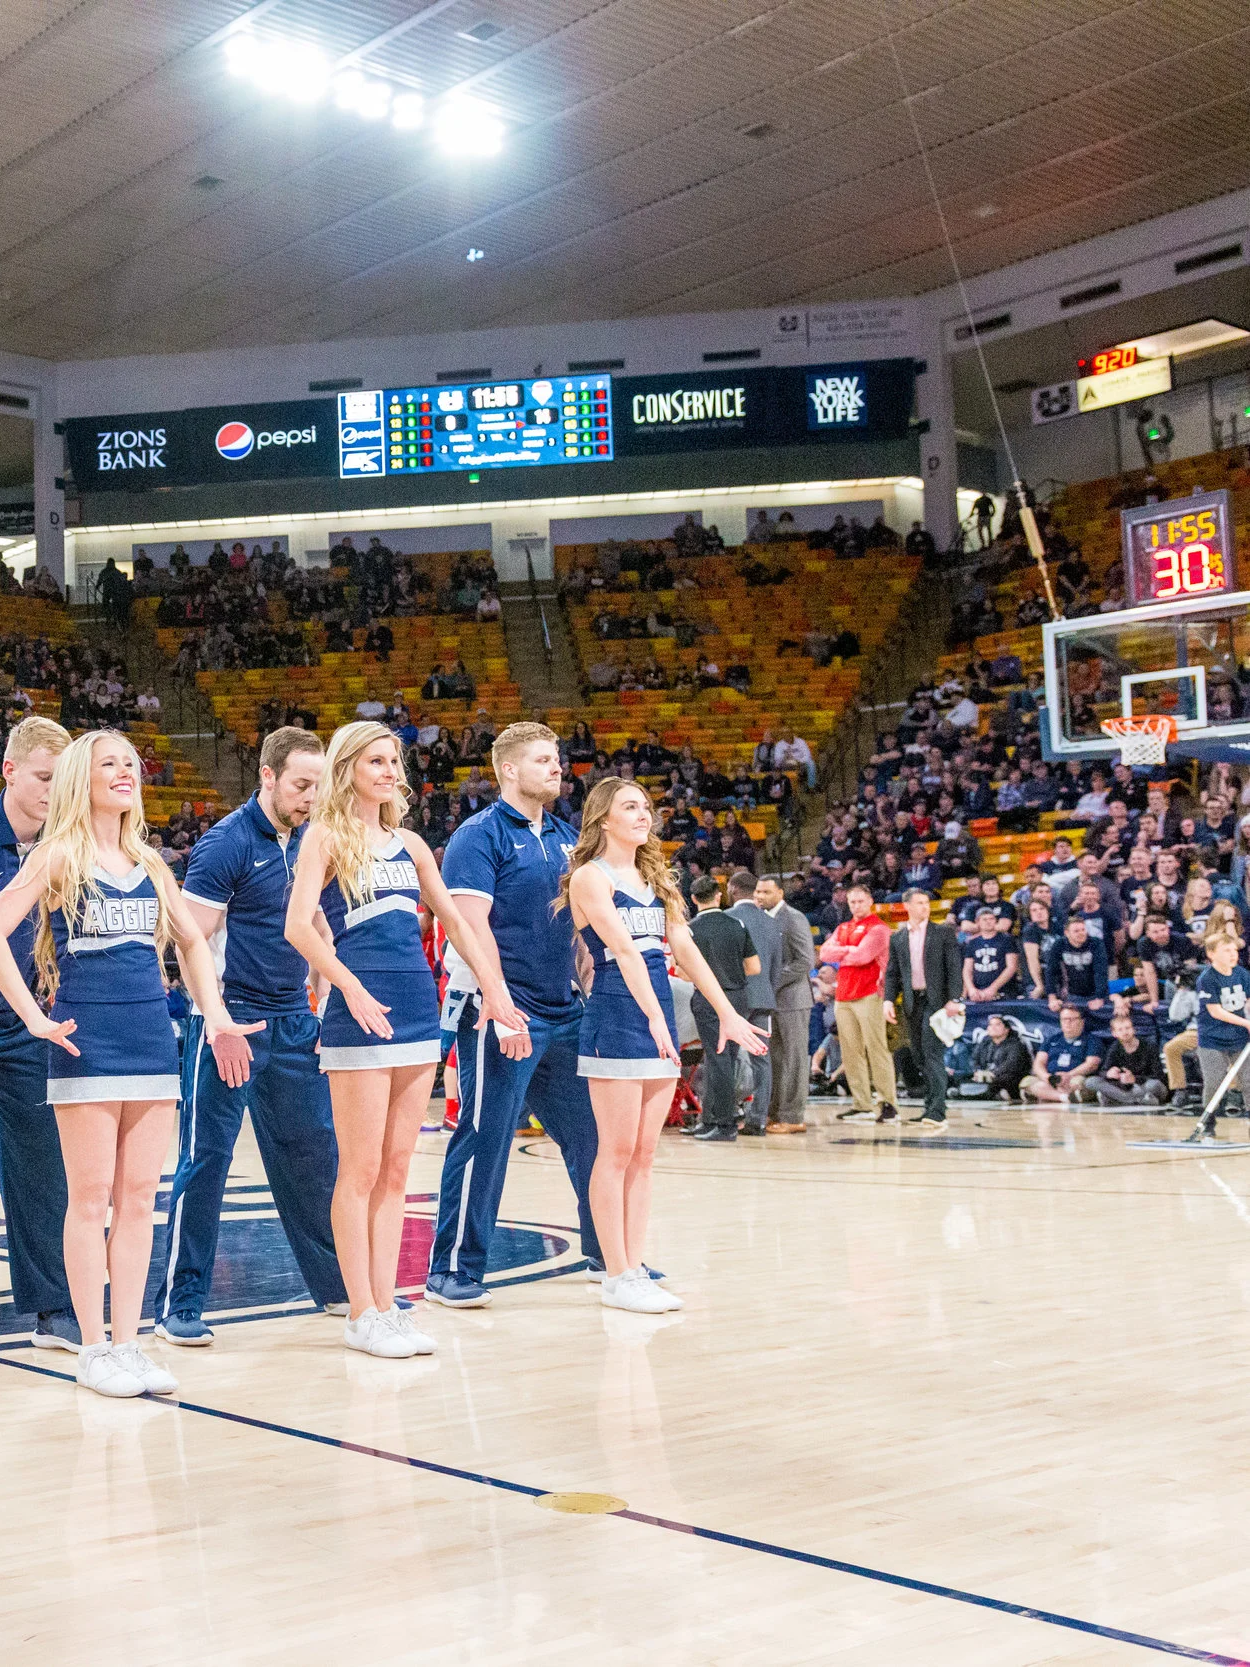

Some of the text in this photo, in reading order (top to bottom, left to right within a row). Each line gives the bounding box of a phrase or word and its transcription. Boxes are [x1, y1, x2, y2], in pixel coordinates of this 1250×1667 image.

[1093, 347, 1137, 376] 920
[815, 377, 859, 395] NEW
[633, 388, 746, 424] CONSERVICE
[809, 389, 865, 410] YORK
[817, 406, 860, 424] LIFE
[97, 428, 167, 451] ZIONS
[257, 425, 317, 450] pepsi
[98, 449, 167, 471] BANK
[1151, 511, 1216, 547] 11:55
[1153, 543, 1211, 598] 30
